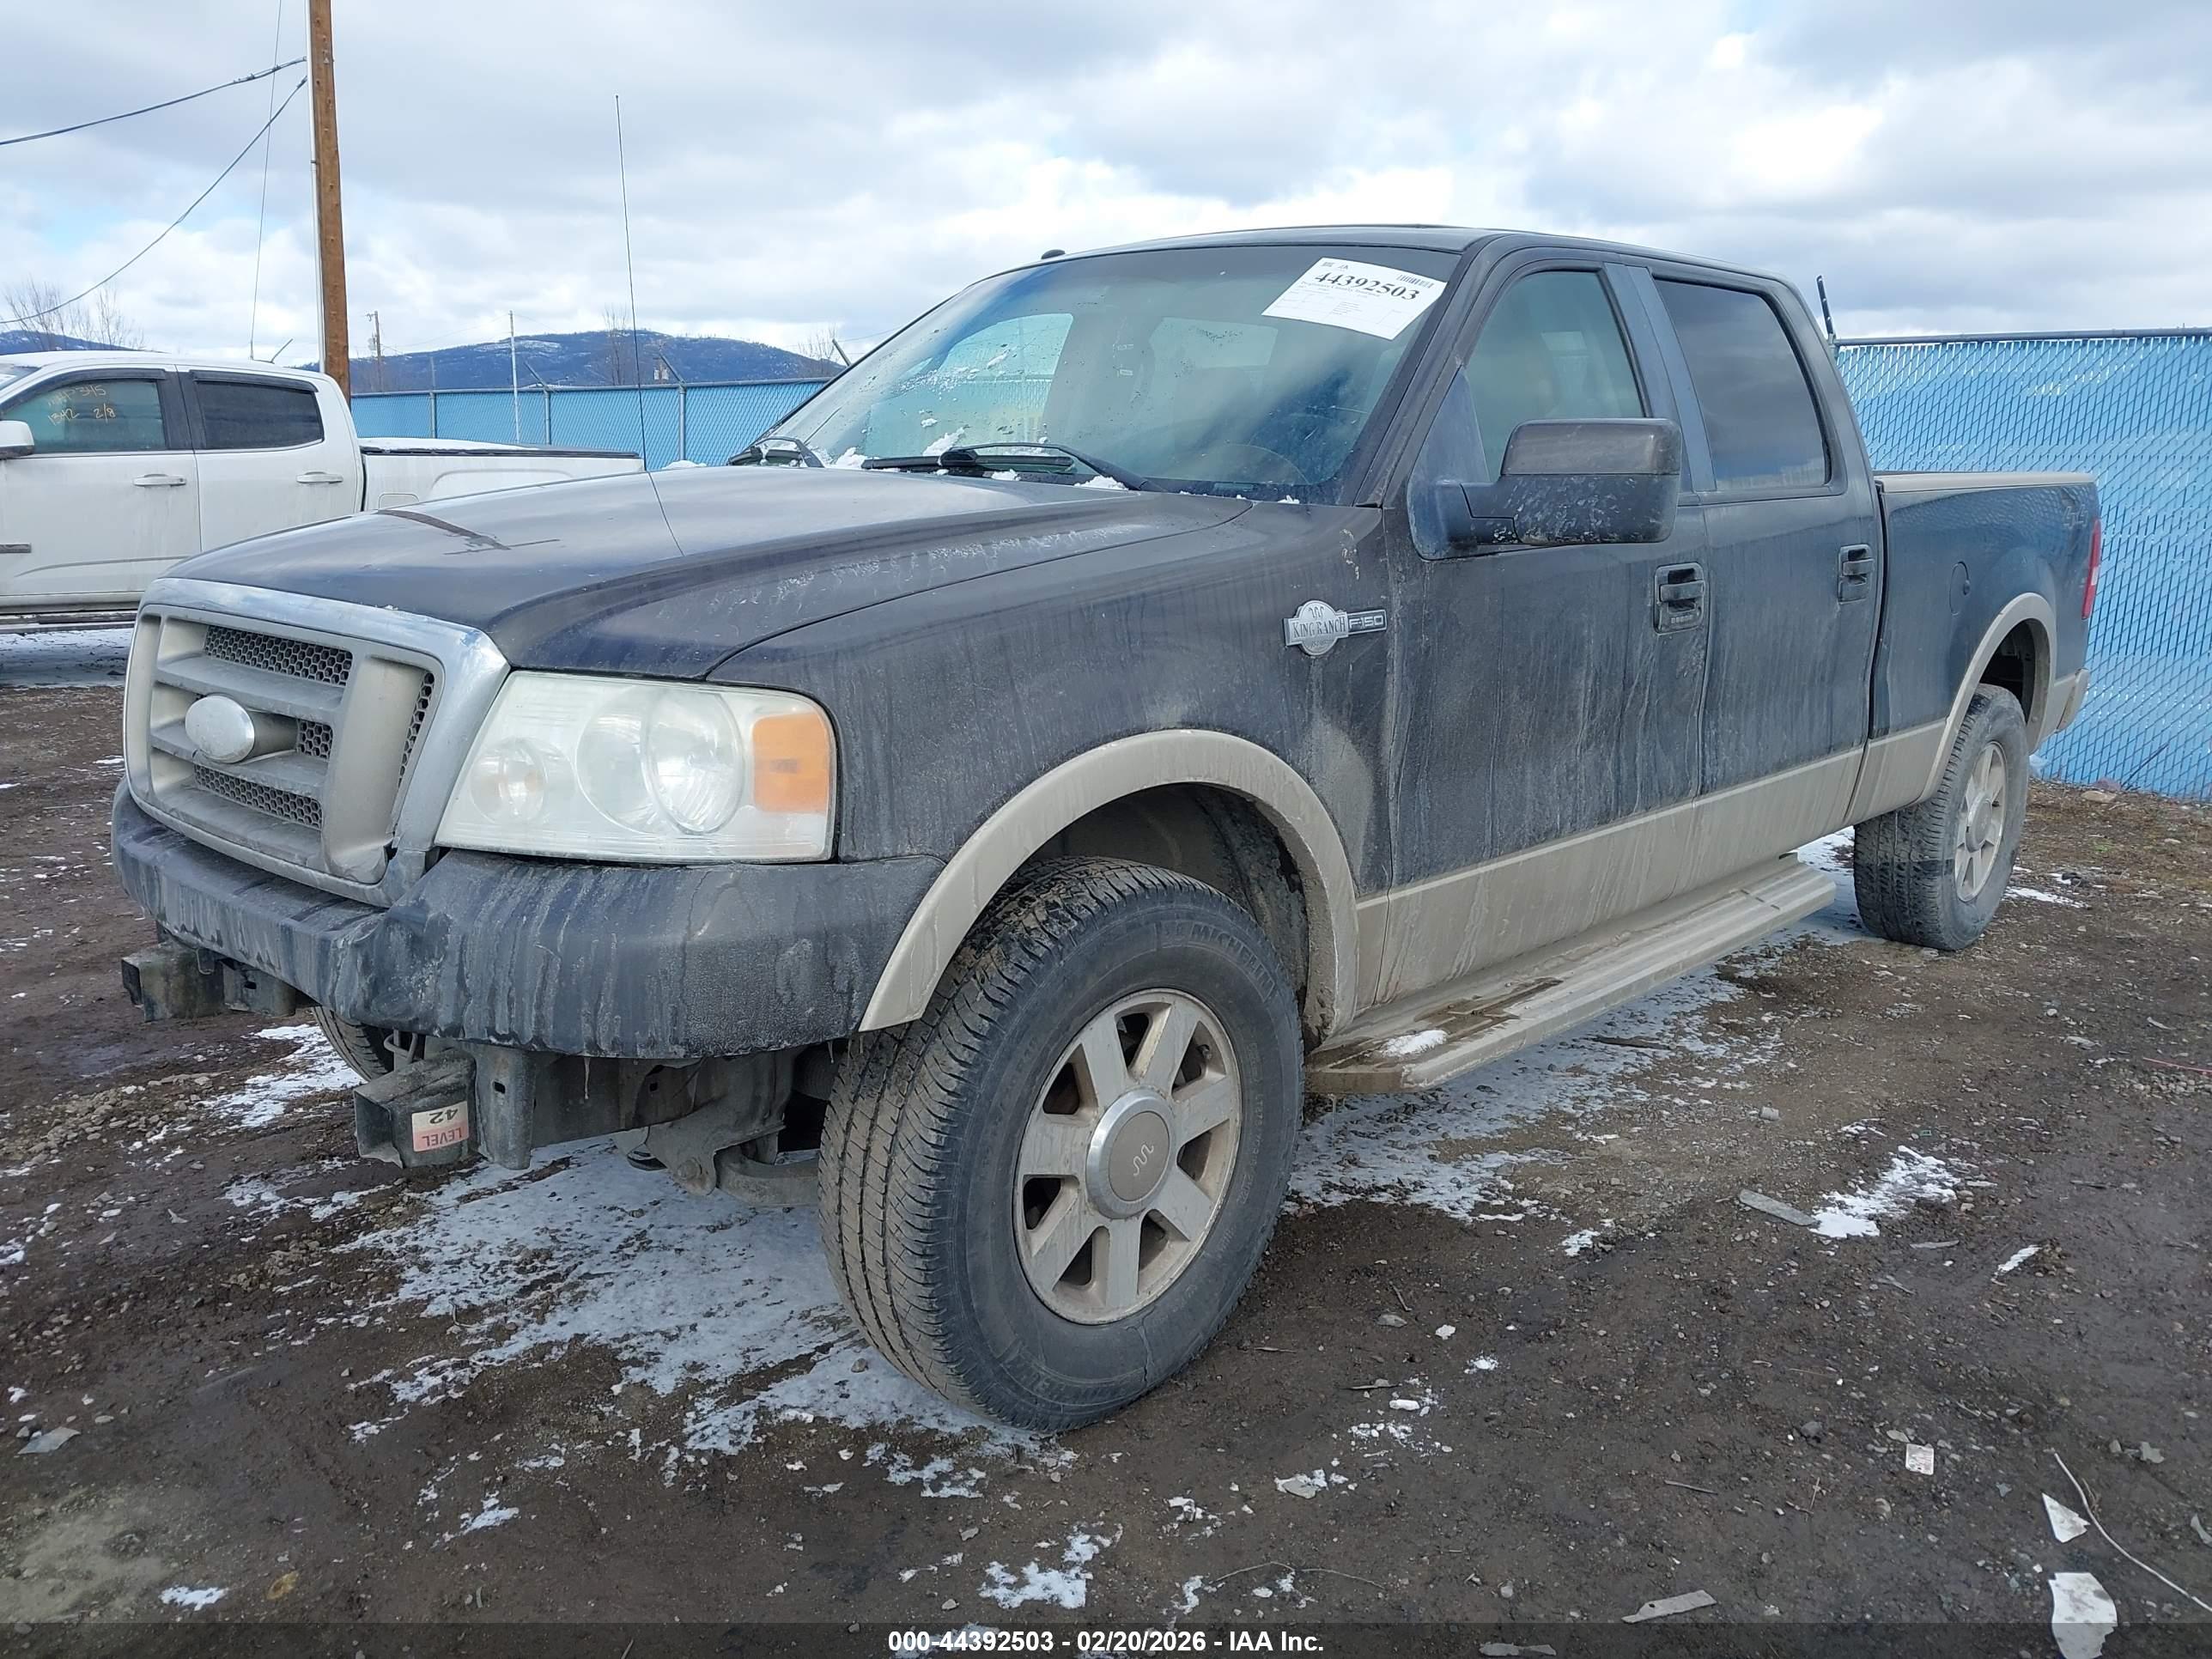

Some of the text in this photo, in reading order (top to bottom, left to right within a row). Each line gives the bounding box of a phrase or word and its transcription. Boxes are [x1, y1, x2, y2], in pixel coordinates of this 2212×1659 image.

[1315, 271, 1420, 301] 44392503
[93, 403, 116, 423] 2/8
[1292, 615, 1384, 638] KING RANCH F-150
[428, 1107, 459, 1125] 42
[422, 1127, 464, 1147] LEVEL
